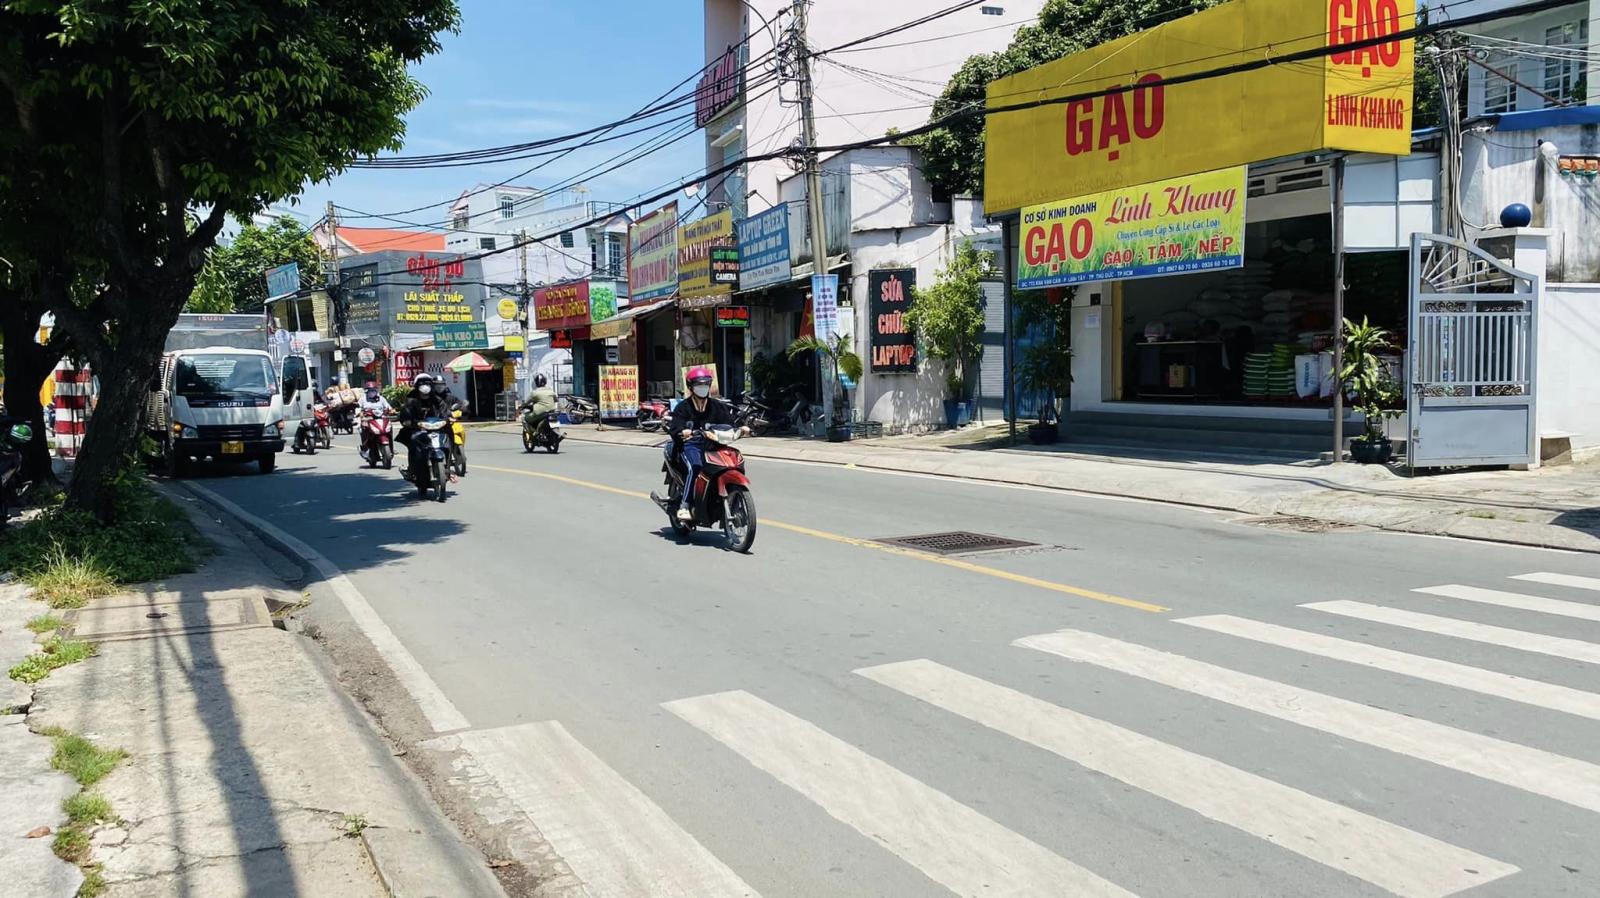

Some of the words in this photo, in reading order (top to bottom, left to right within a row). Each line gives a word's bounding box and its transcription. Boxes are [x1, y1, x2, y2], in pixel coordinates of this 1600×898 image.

[1329, 0, 1400, 78] GẠO
[1066, 73, 1164, 162] GẠO
[1327, 94, 1358, 127] LINH
[1360, 96, 1404, 131] KHANG
[1048, 206, 1067, 219] KINH
[1069, 201, 1097, 217] DOANH
[1104, 192, 1152, 225] Linh
[1158, 184, 1236, 217] Khang
[739, 217, 762, 244] LAPTOP
[1025, 218, 1093, 272] GẠO
[1148, 238, 1182, 260] TẤM
[1199, 230, 1234, 254] NẾP
[716, 272, 737, 280] CAMERA
[881, 274, 904, 302] SỬA
[397, 353, 420, 367] DÁN
[873, 344, 915, 366] LAPTOP
